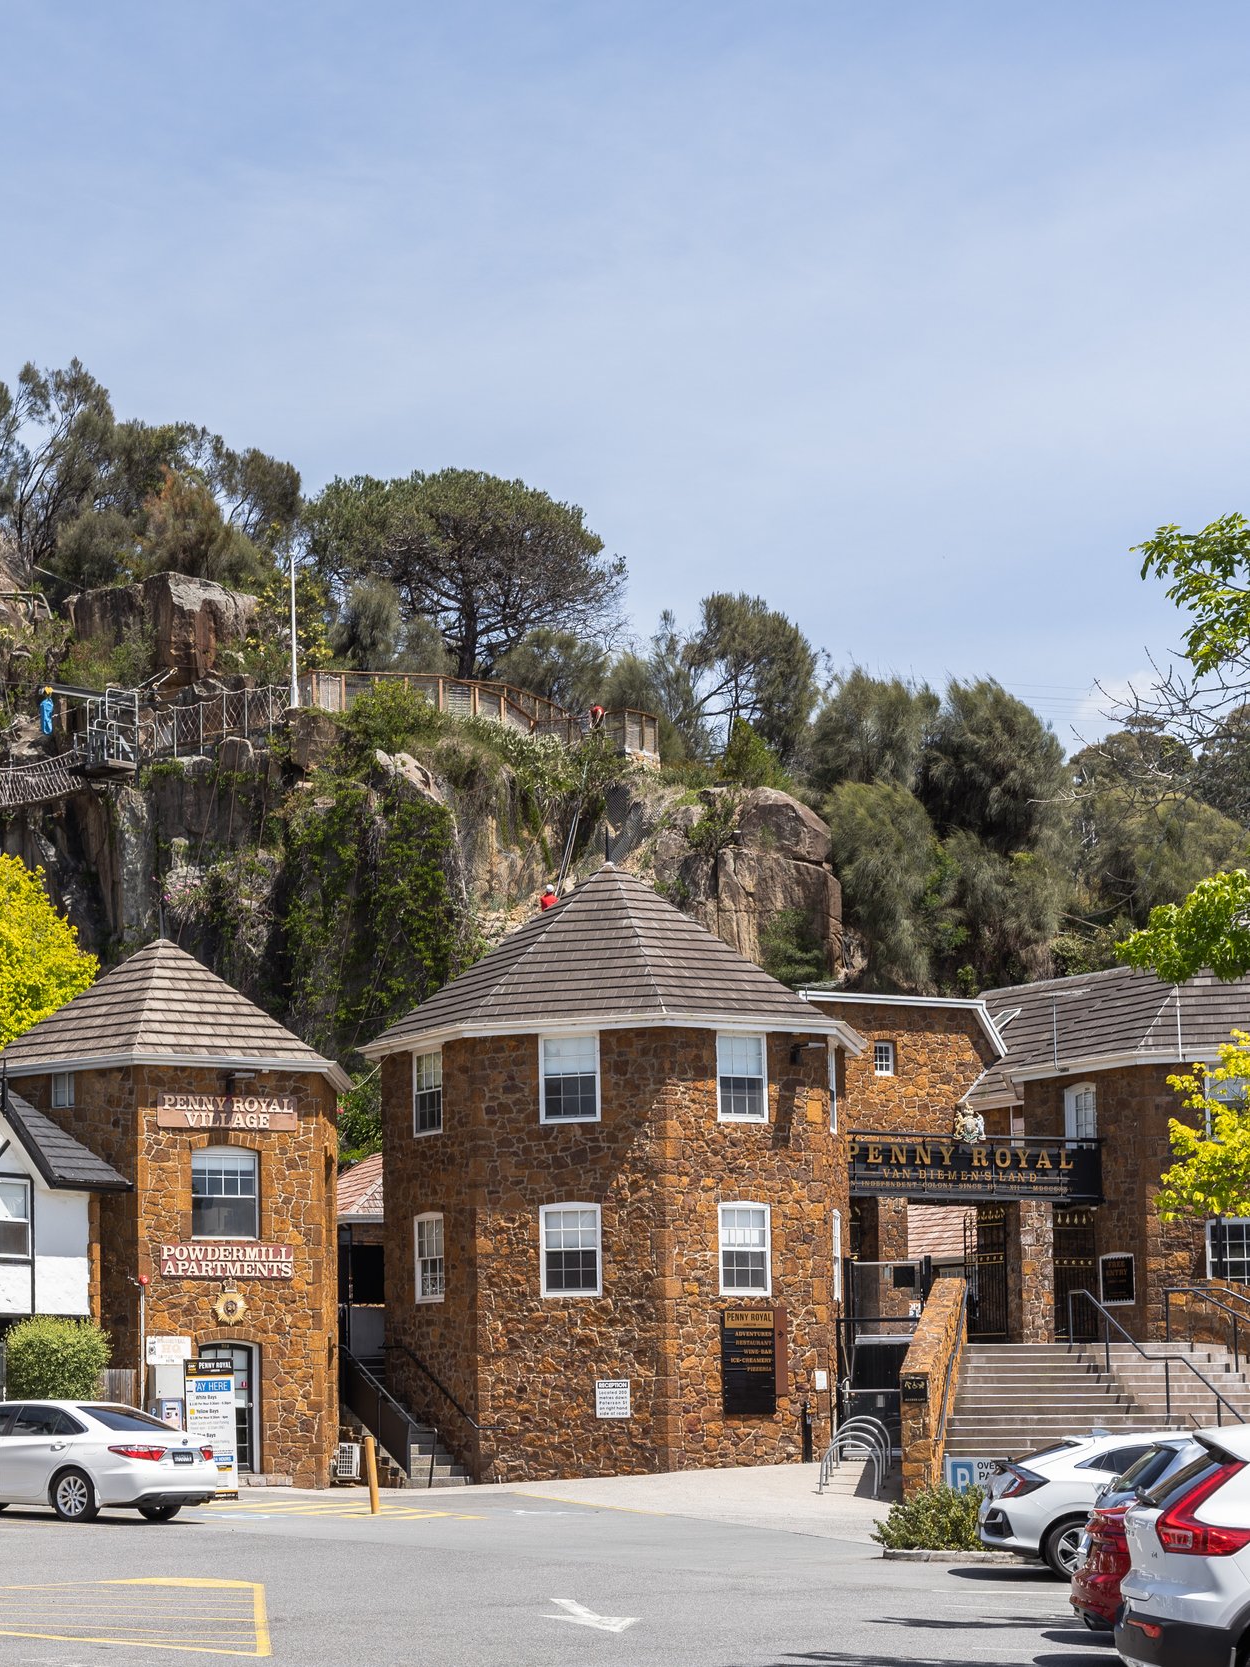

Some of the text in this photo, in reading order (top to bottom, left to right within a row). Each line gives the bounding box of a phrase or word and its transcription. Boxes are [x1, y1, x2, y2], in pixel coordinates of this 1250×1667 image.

[163, 1095, 293, 1113] PENNY ROYAL
[184, 1112, 269, 1128] VILLAGE
[847, 1143, 1074, 1169] PENNY ROYAL
[882, 1168, 1037, 1182] VAN DIEMEN'S LAND
[161, 1245, 293, 1261] POWDERMILL
[163, 1261, 292, 1277] APARTMENTS
[727, 1312, 772, 1321] PENNY ROYAL
[216, 1361, 232, 1369] ROYAL
[196, 1381, 228, 1391] AY HERE
[956, 1461, 995, 1493] P OVE
